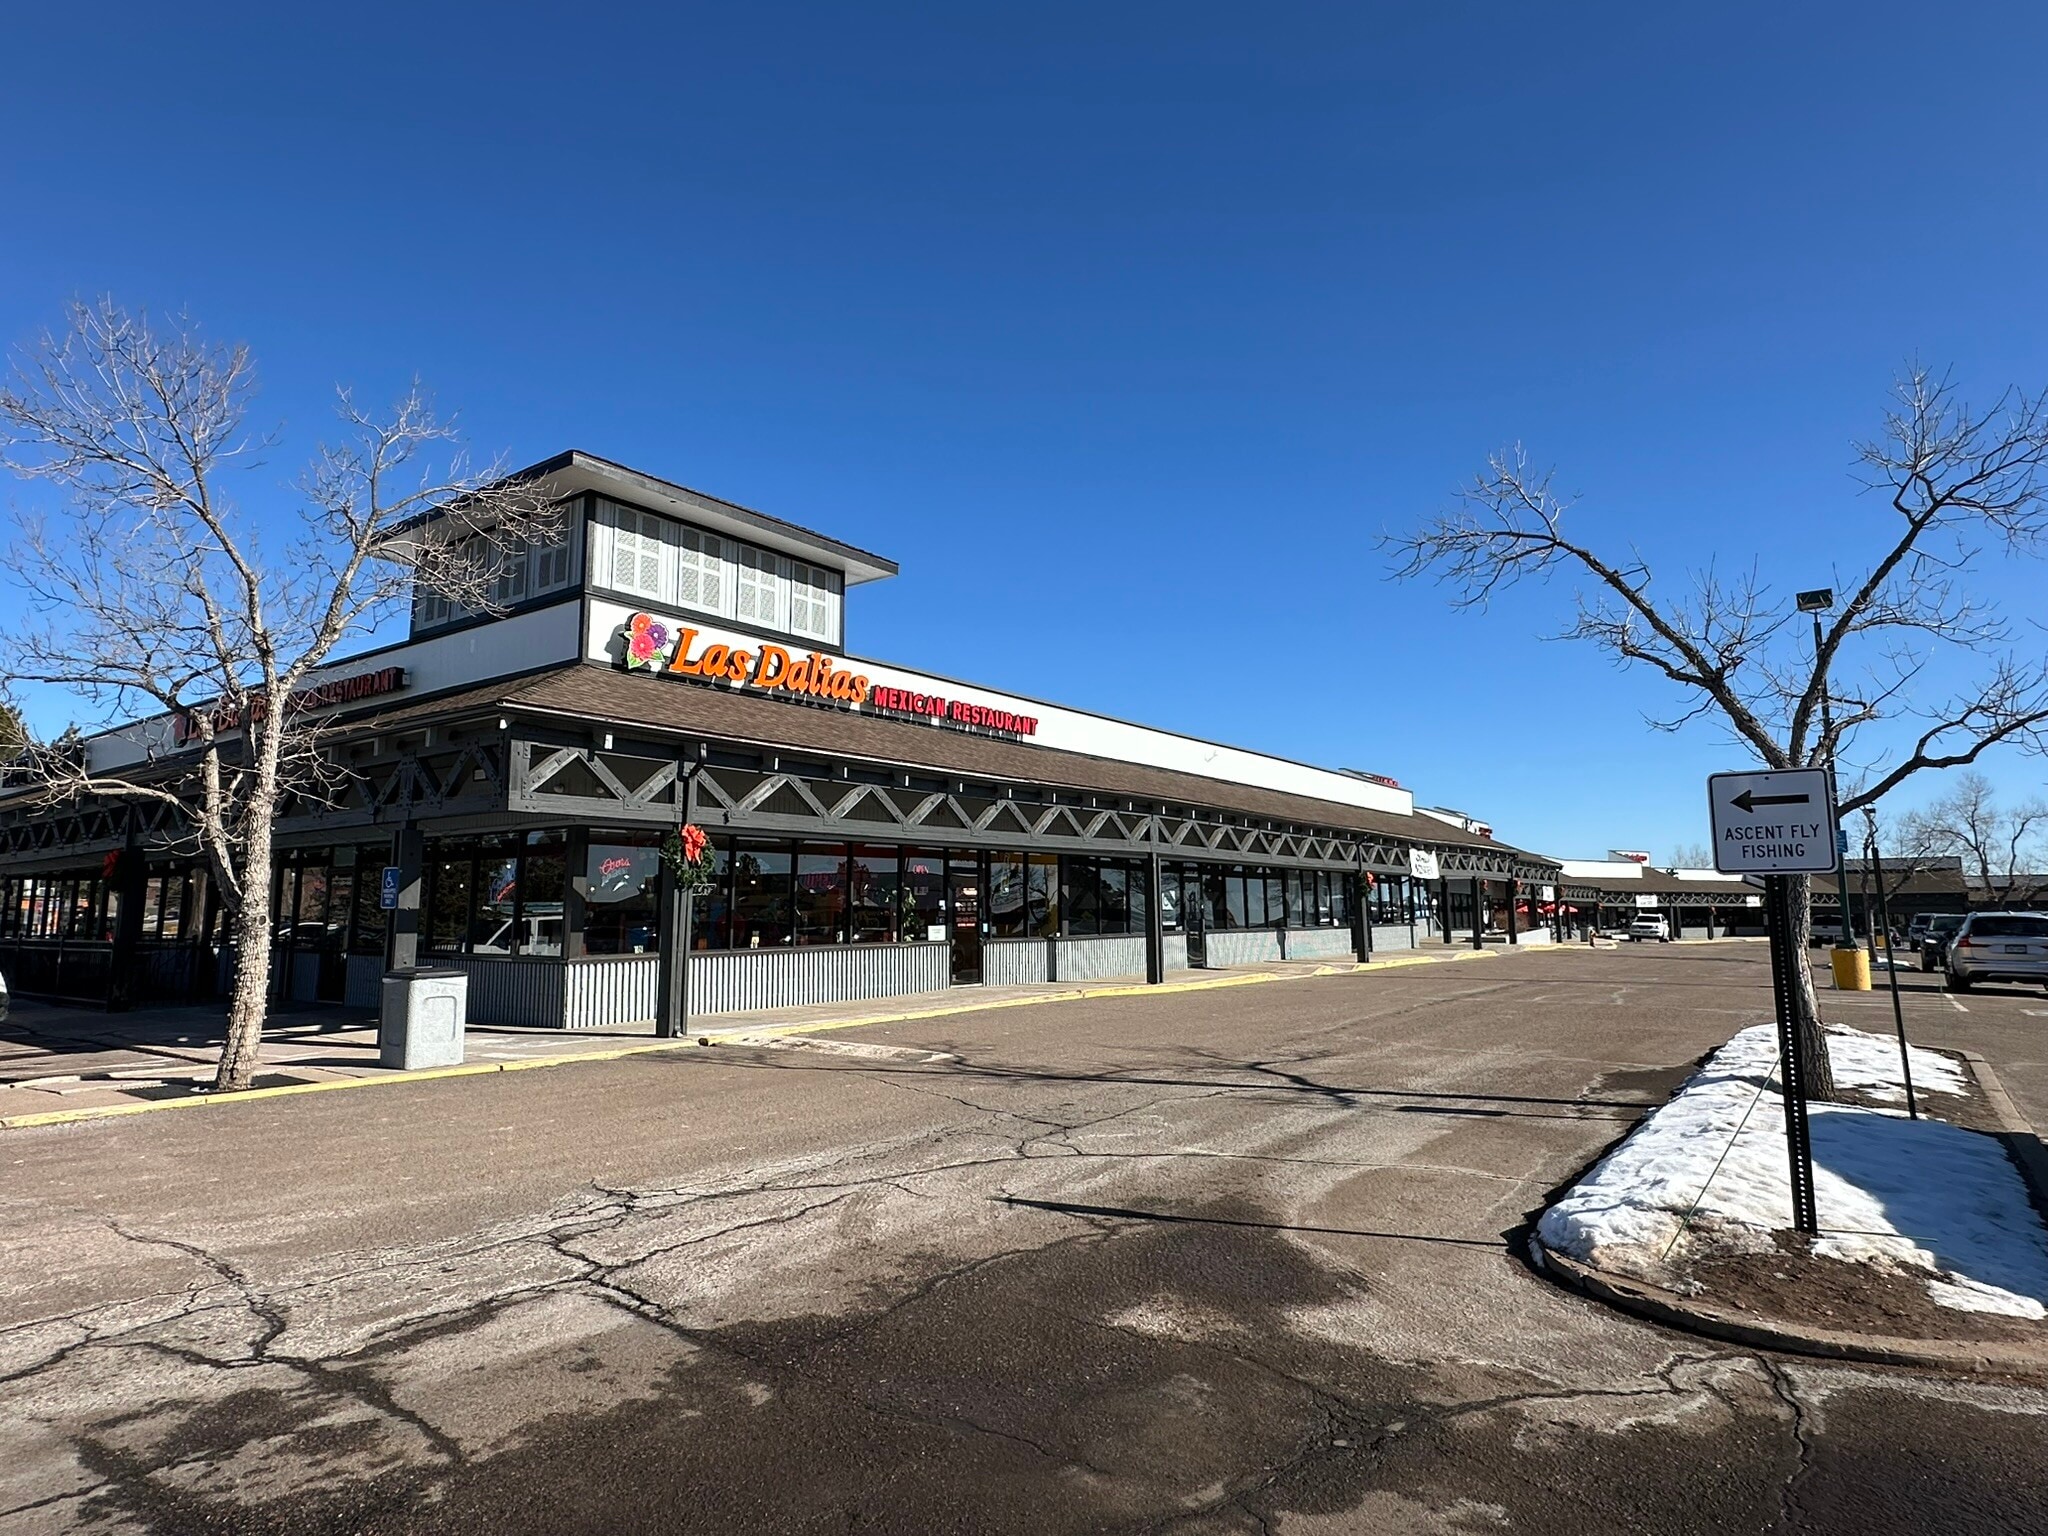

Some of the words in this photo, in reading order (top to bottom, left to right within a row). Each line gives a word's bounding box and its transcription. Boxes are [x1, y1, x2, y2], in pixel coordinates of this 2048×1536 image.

[669, 627, 752, 681] Las
[752, 644, 870, 703] Dalias
[321, 667, 397, 706] RESTAURANT
[873, 685, 946, 718] MEXICAN
[952, 700, 1039, 736] RESTAURANT
[1724, 825, 1784, 841] ASCENT
[1790, 823, 1820, 839] FLY
[1741, 843, 1805, 859] FISHING
